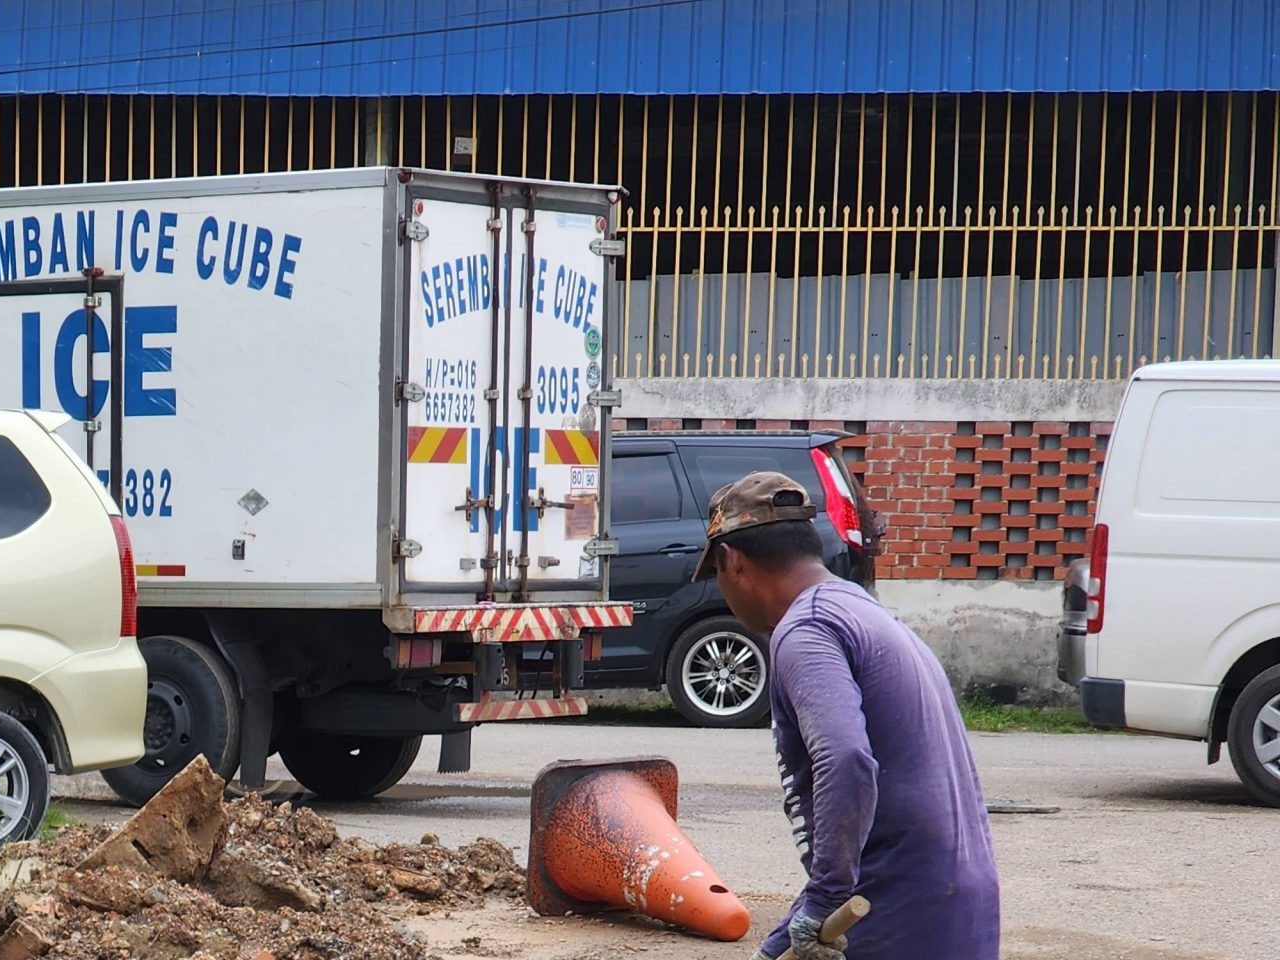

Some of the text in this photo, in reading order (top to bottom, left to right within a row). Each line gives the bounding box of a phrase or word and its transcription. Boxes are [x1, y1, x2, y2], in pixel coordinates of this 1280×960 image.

[114, 208, 179, 275] ICE
[195, 215, 303, 300] CUBE
[421, 252, 598, 334] SEREMB IE CUBE
[21, 305, 178, 422] ICE
[425, 392, 476, 424] 6657382
[536, 364, 580, 415] 3095
[571, 470, 582, 485] 80
[585, 474, 595, 487] 90
